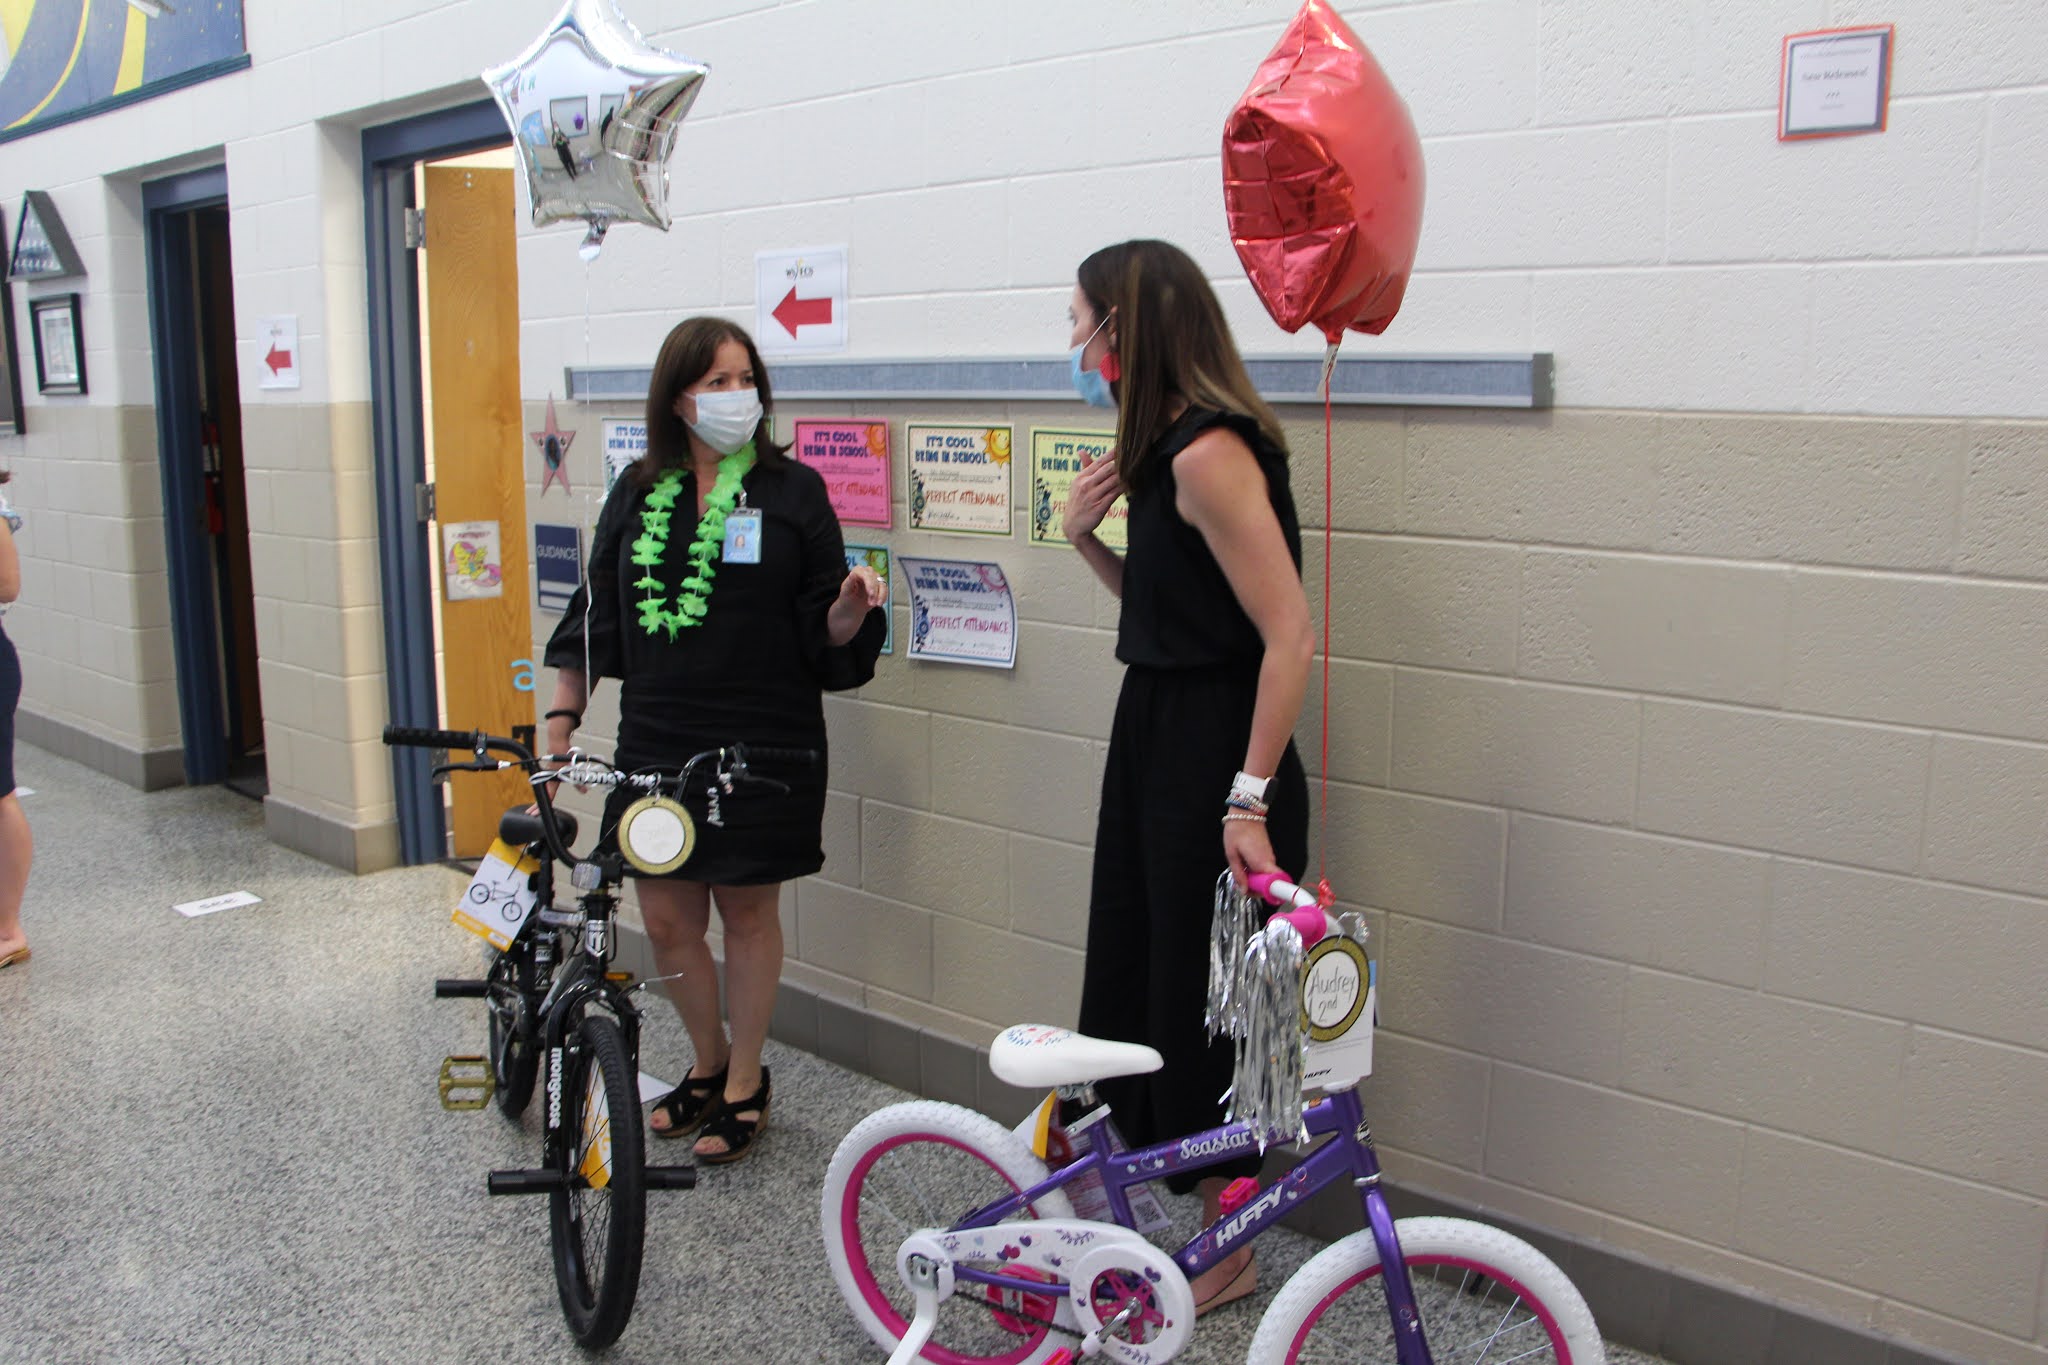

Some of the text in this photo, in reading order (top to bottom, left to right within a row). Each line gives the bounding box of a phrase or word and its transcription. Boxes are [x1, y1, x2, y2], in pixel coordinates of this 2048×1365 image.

[629, 426, 646, 436] COO
[815, 431, 858, 442] IT'S COOL
[926, 435, 975, 448] IT'S COOL
[1054, 443, 1074, 455] IT'S
[804, 445, 868, 458] BEING IN SCHOOL
[915, 450, 988, 464] BEING IN SCHOOL
[1041, 457, 1081, 472] BEING IN
[847, 482, 884, 496] ATTENDANCE
[926, 489, 1005, 506] PERFECT ATTENDANCE
[537, 545, 577, 561] GUIDANCE
[921, 566, 970, 579] IT'S COOL
[915, 578, 986, 593] BEING IN SCHOOL
[930, 615, 1009, 634] PERFECT ATTENDANCE
[1309, 966, 1356, 998] Audrey
[547, 1048, 562, 1128] mongoose
[1180, 1129, 1250, 1160] Seastar
[1216, 1184, 1283, 1249] HUFFY
